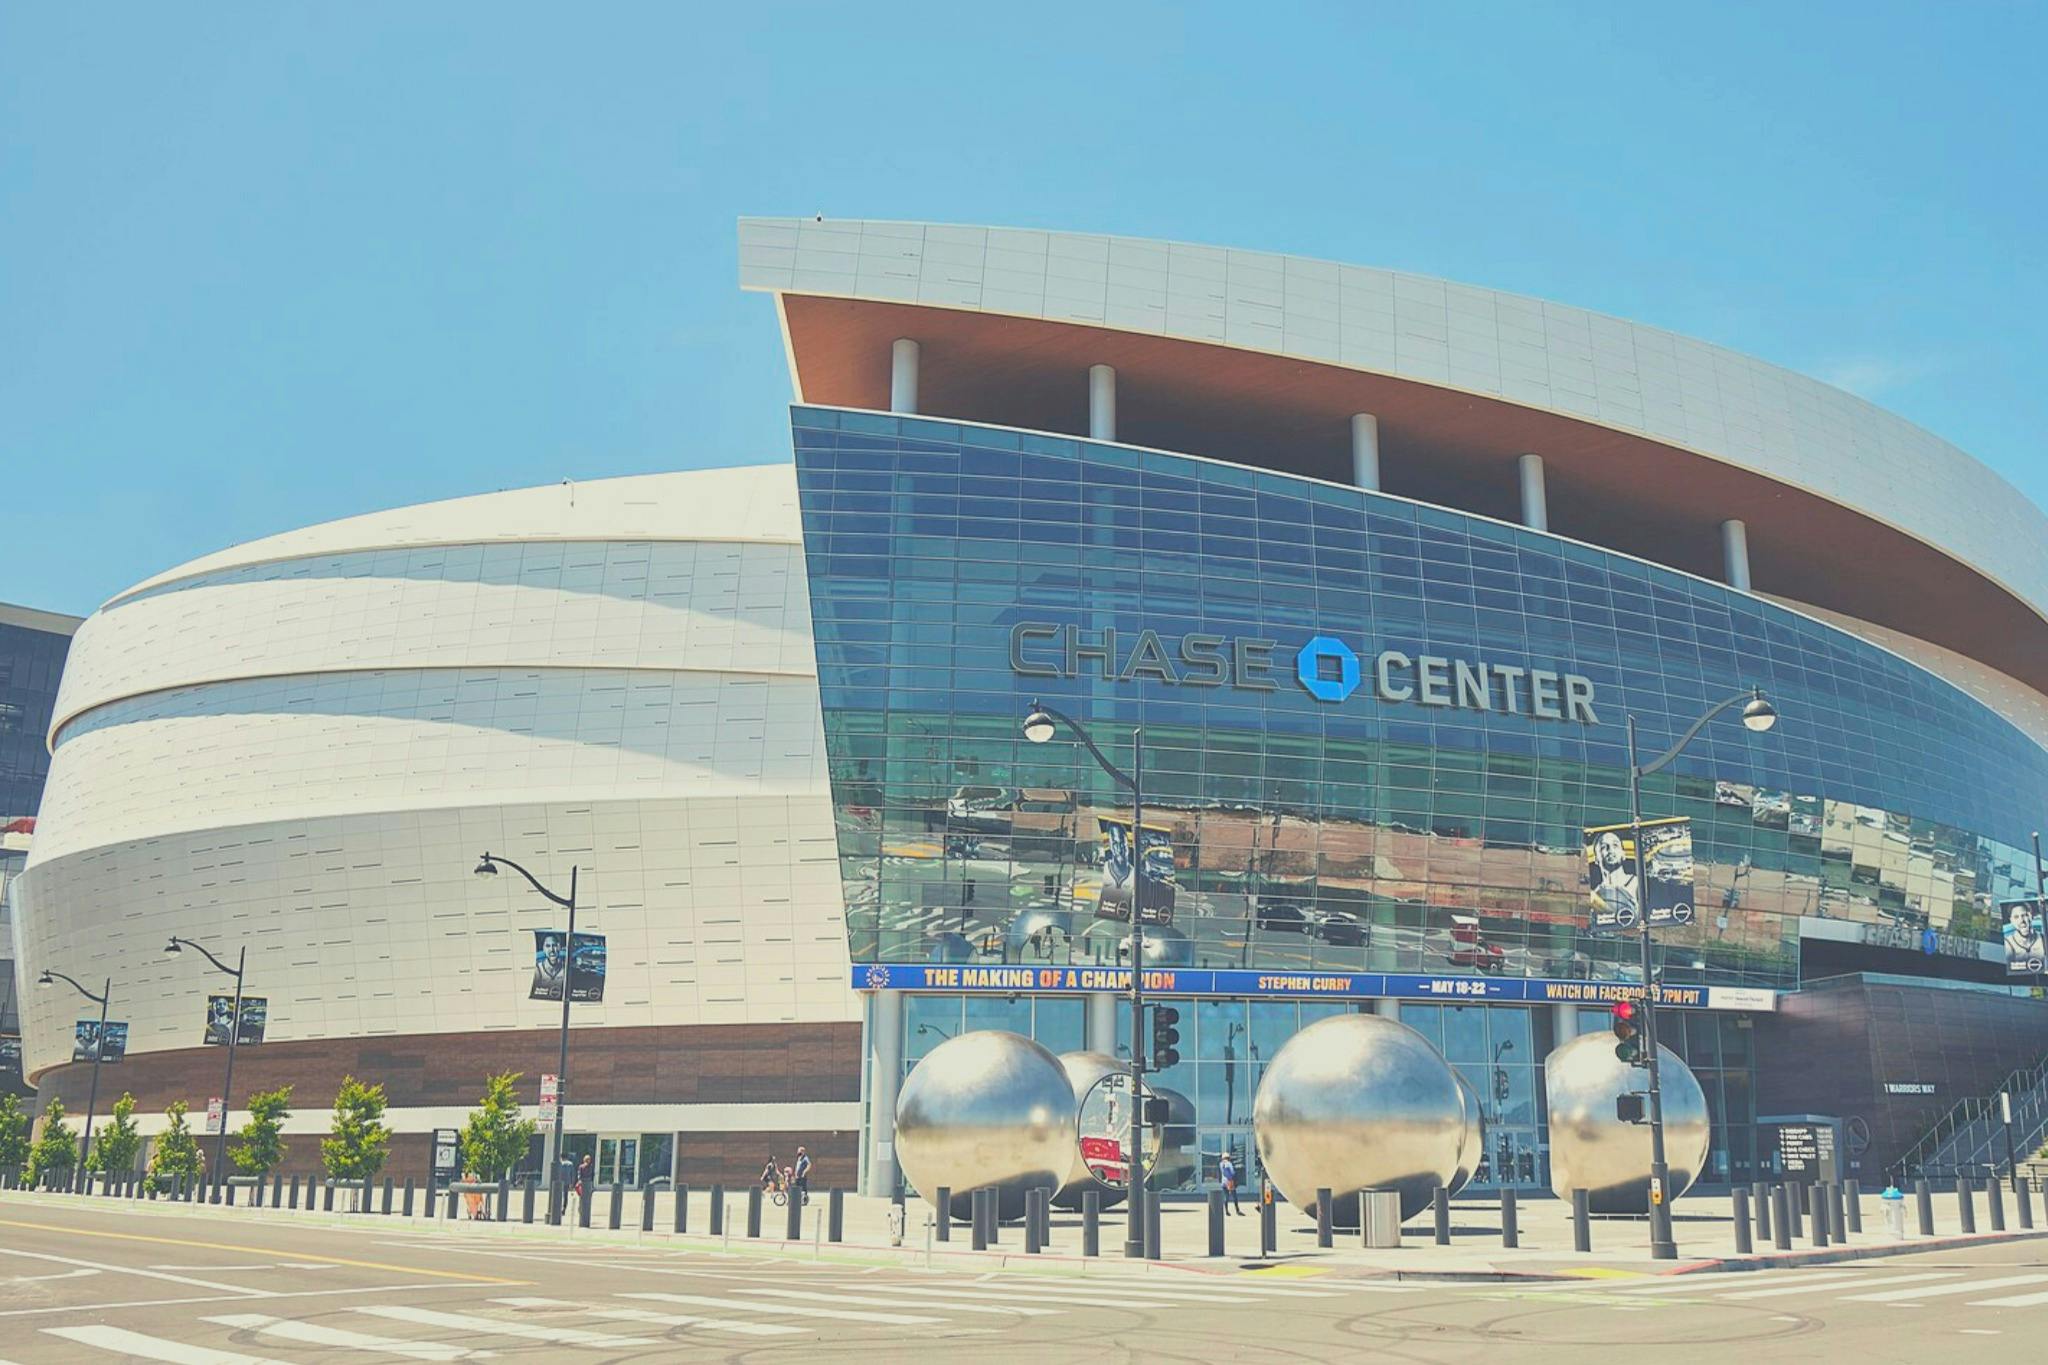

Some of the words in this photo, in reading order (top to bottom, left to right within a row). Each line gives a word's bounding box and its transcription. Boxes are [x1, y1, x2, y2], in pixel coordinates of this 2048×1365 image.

[1009, 620, 1283, 691] CHASE
[1378, 649, 1601, 727] CENTER
[924, 968, 959, 986] THE
[962, 969, 1034, 987] MAKING
[1039, 970, 1062, 988] OF
[1065, 971, 1078, 987] A
[1258, 975, 1311, 991] STEPHEN
[1312, 977, 1352, 991] CURRY
[1432, 981, 1455, 994] MAY
[1546, 983, 1582, 999] WATCH
[1583, 986, 1597, 999] ON
[1663, 989, 1682, 1003] 7PM
